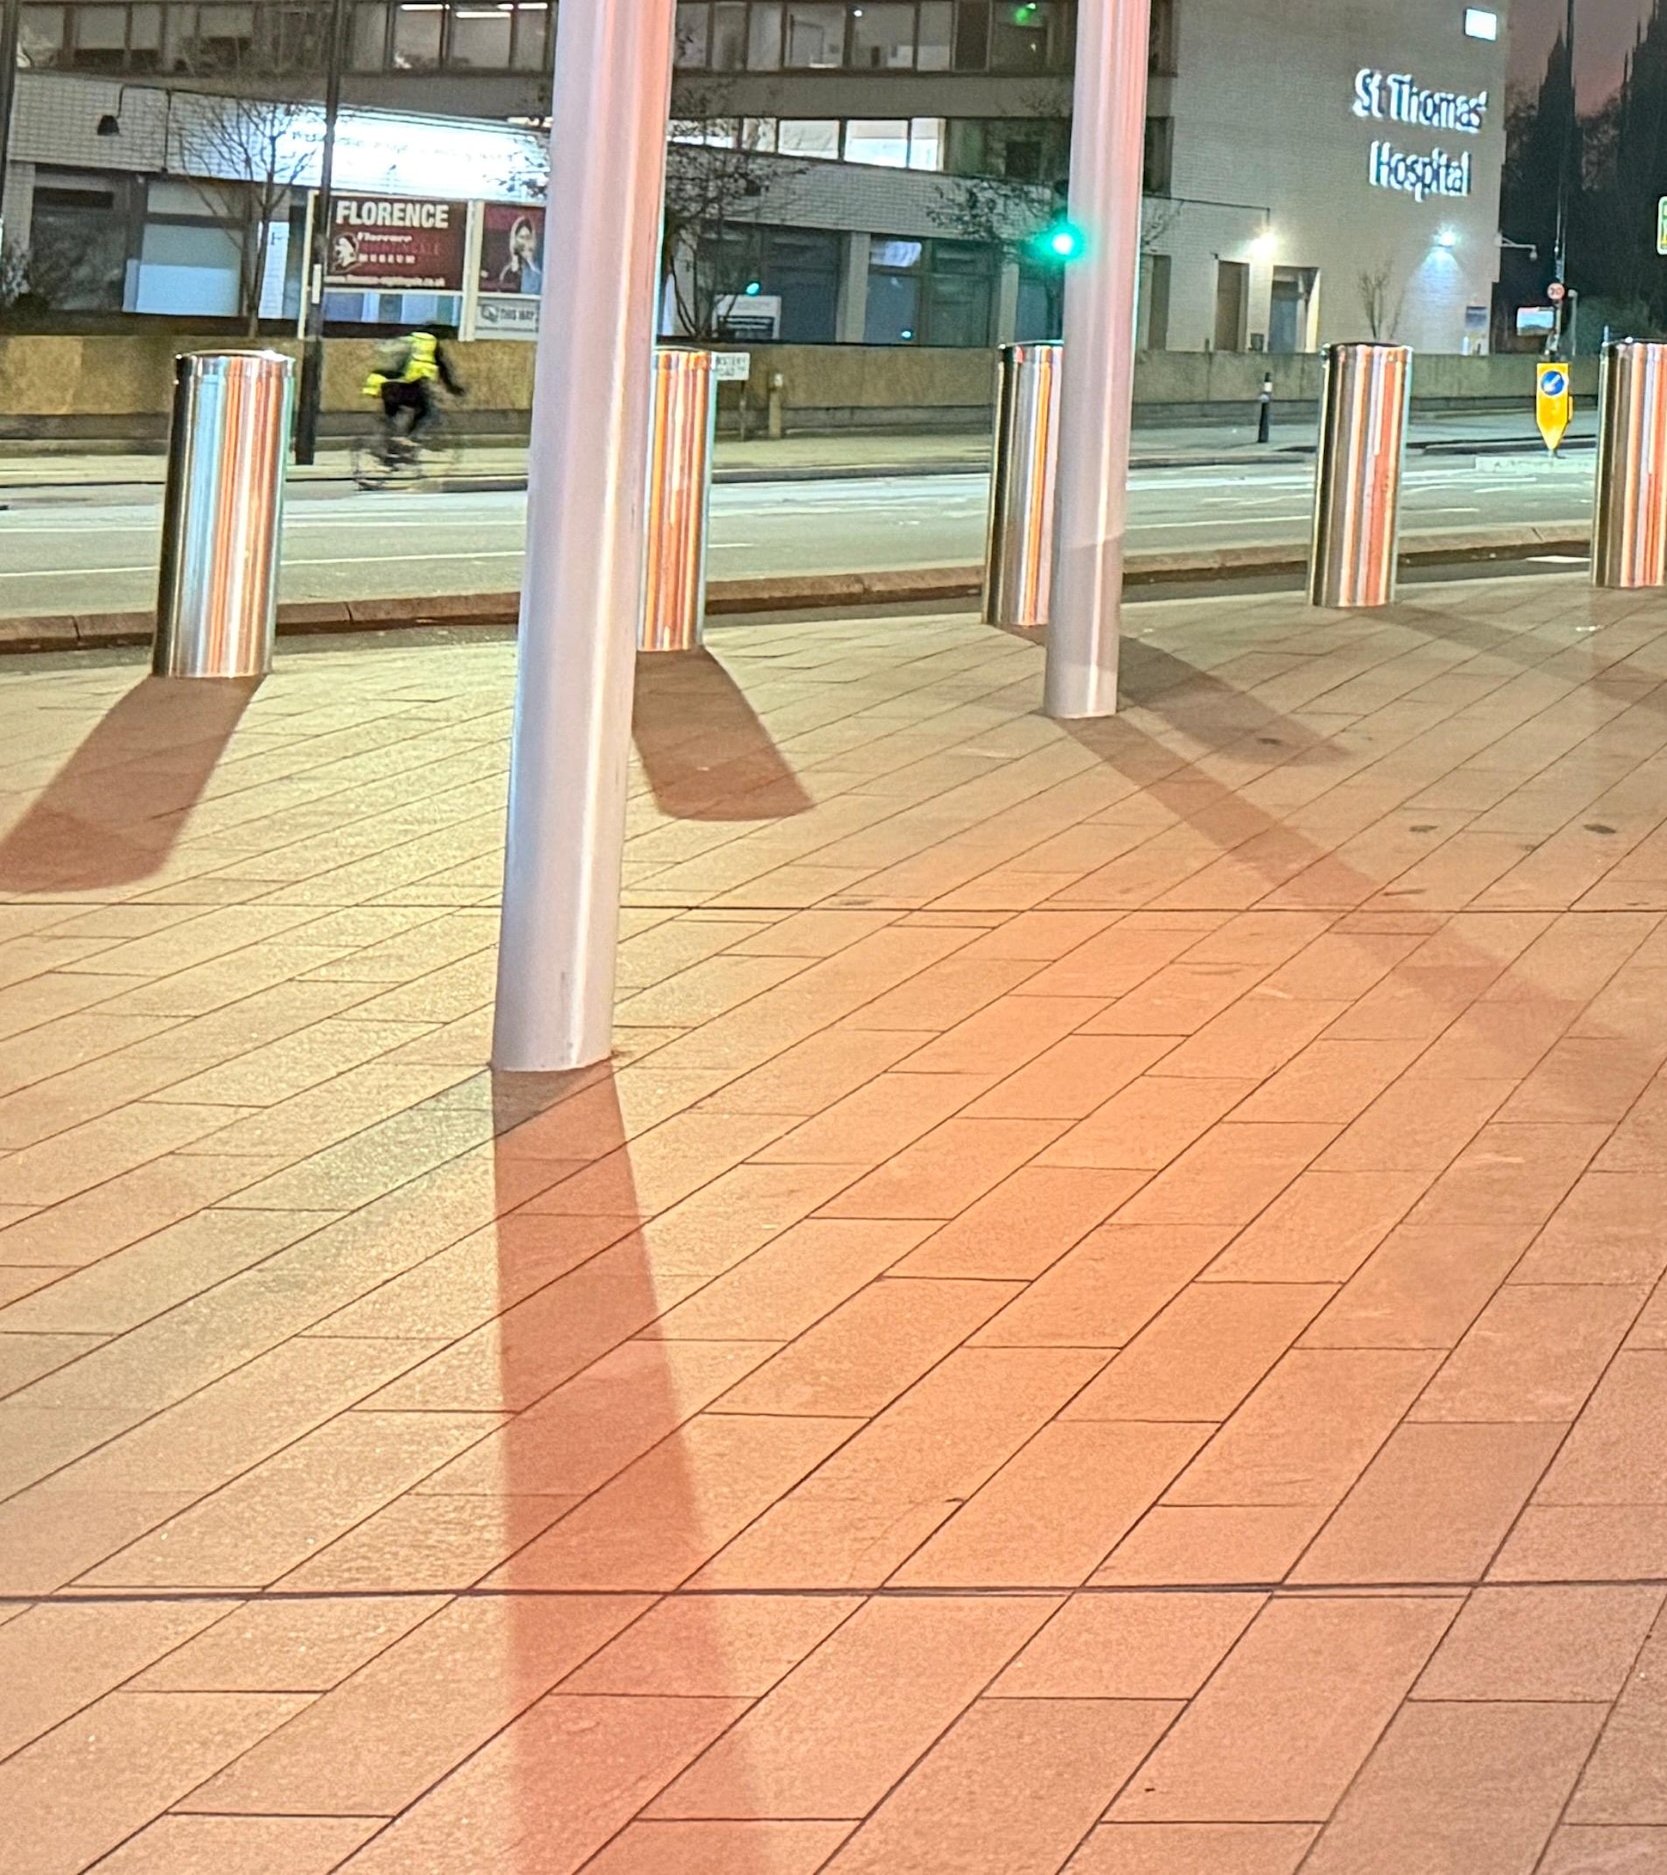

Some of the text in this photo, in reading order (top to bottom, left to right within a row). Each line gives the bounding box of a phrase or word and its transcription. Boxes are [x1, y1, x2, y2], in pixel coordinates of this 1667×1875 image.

[1353, 68, 1383, 118] St
[1369, 140, 1470, 202] Hospital
[335, 200, 449, 229] FLORENCE
[357, 231, 413, 243] Florence
[358, 253, 416, 264] MUSEUM
